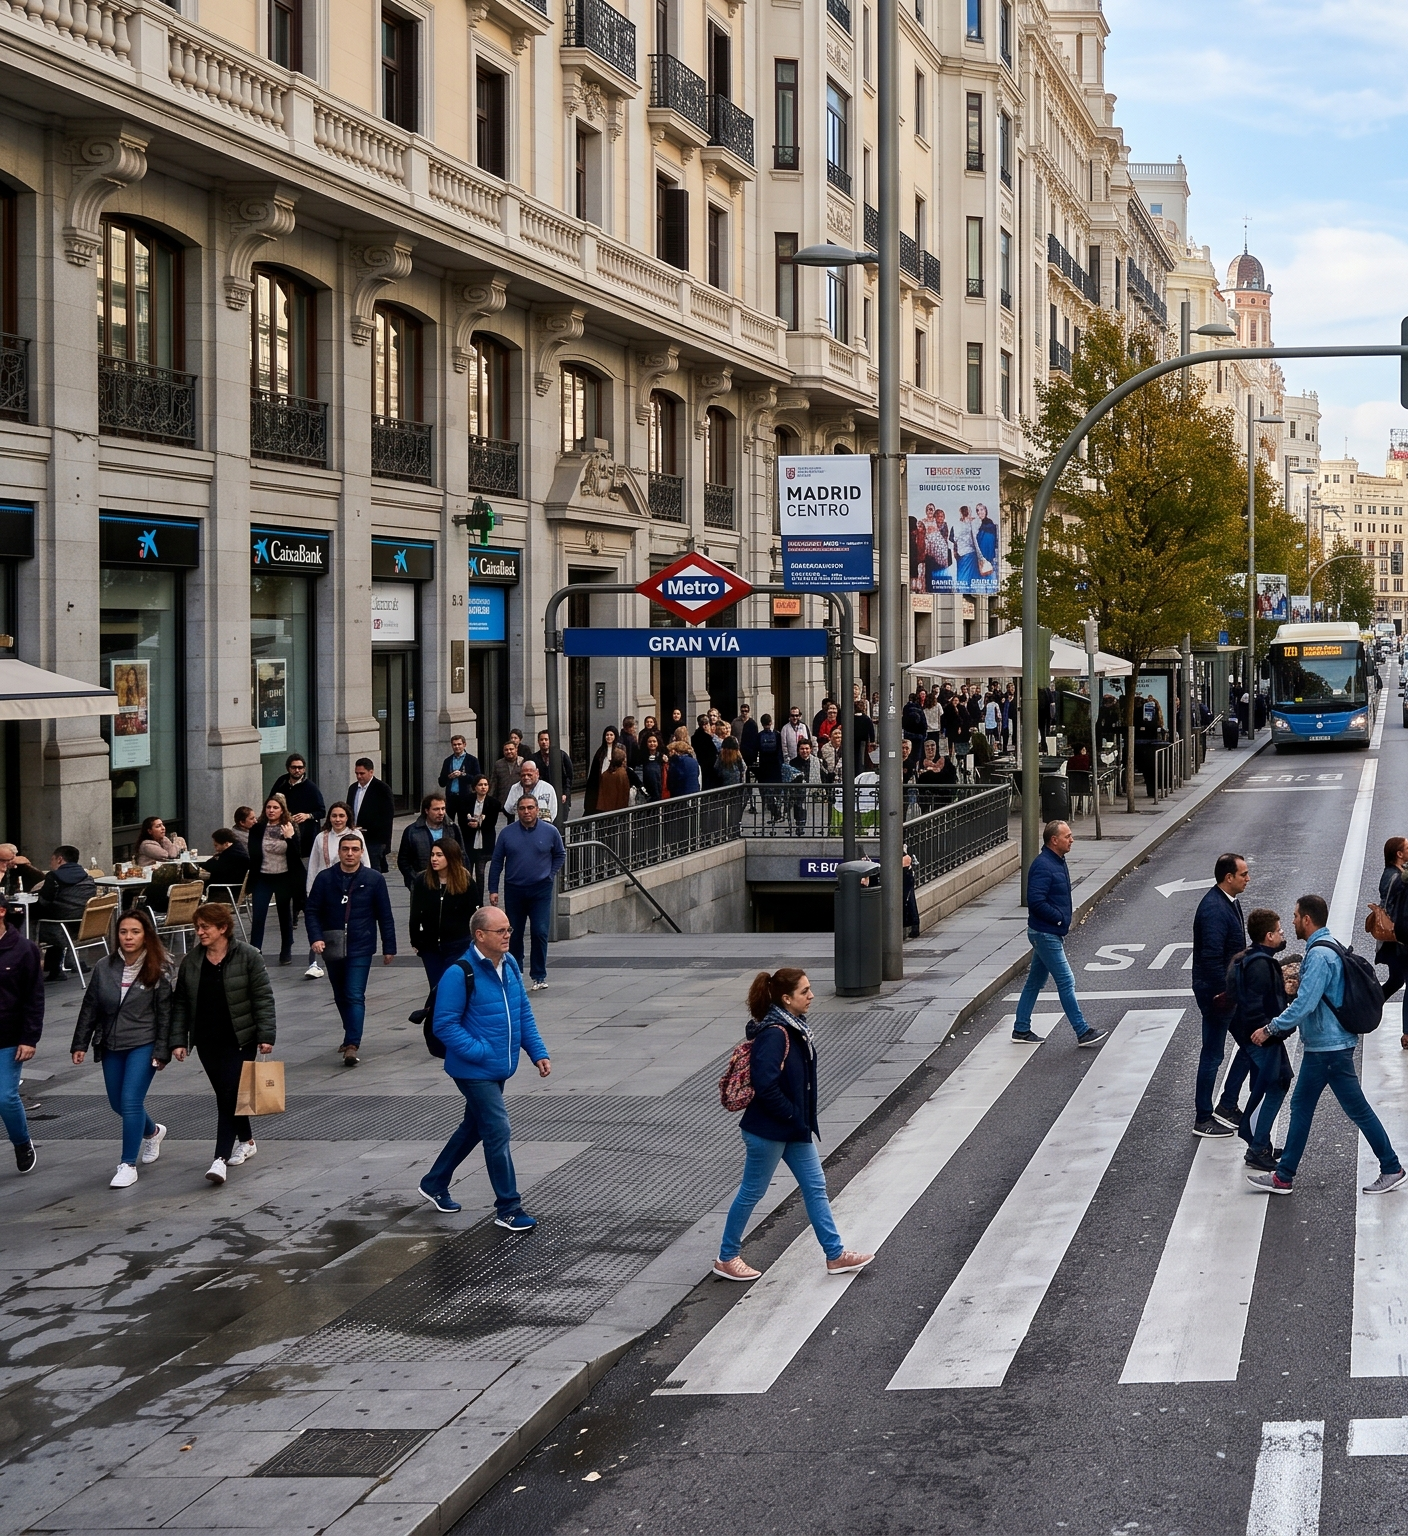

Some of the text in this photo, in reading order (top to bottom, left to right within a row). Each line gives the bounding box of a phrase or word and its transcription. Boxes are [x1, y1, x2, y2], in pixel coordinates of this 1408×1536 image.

[787, 485, 862, 501] MADRID
[786, 503, 850, 517] CENTRO
[270, 540, 323, 564] CaixaBank
[667, 580, 720, 595] Metro
[648, 632, 740, 652] GRAN VÍA
